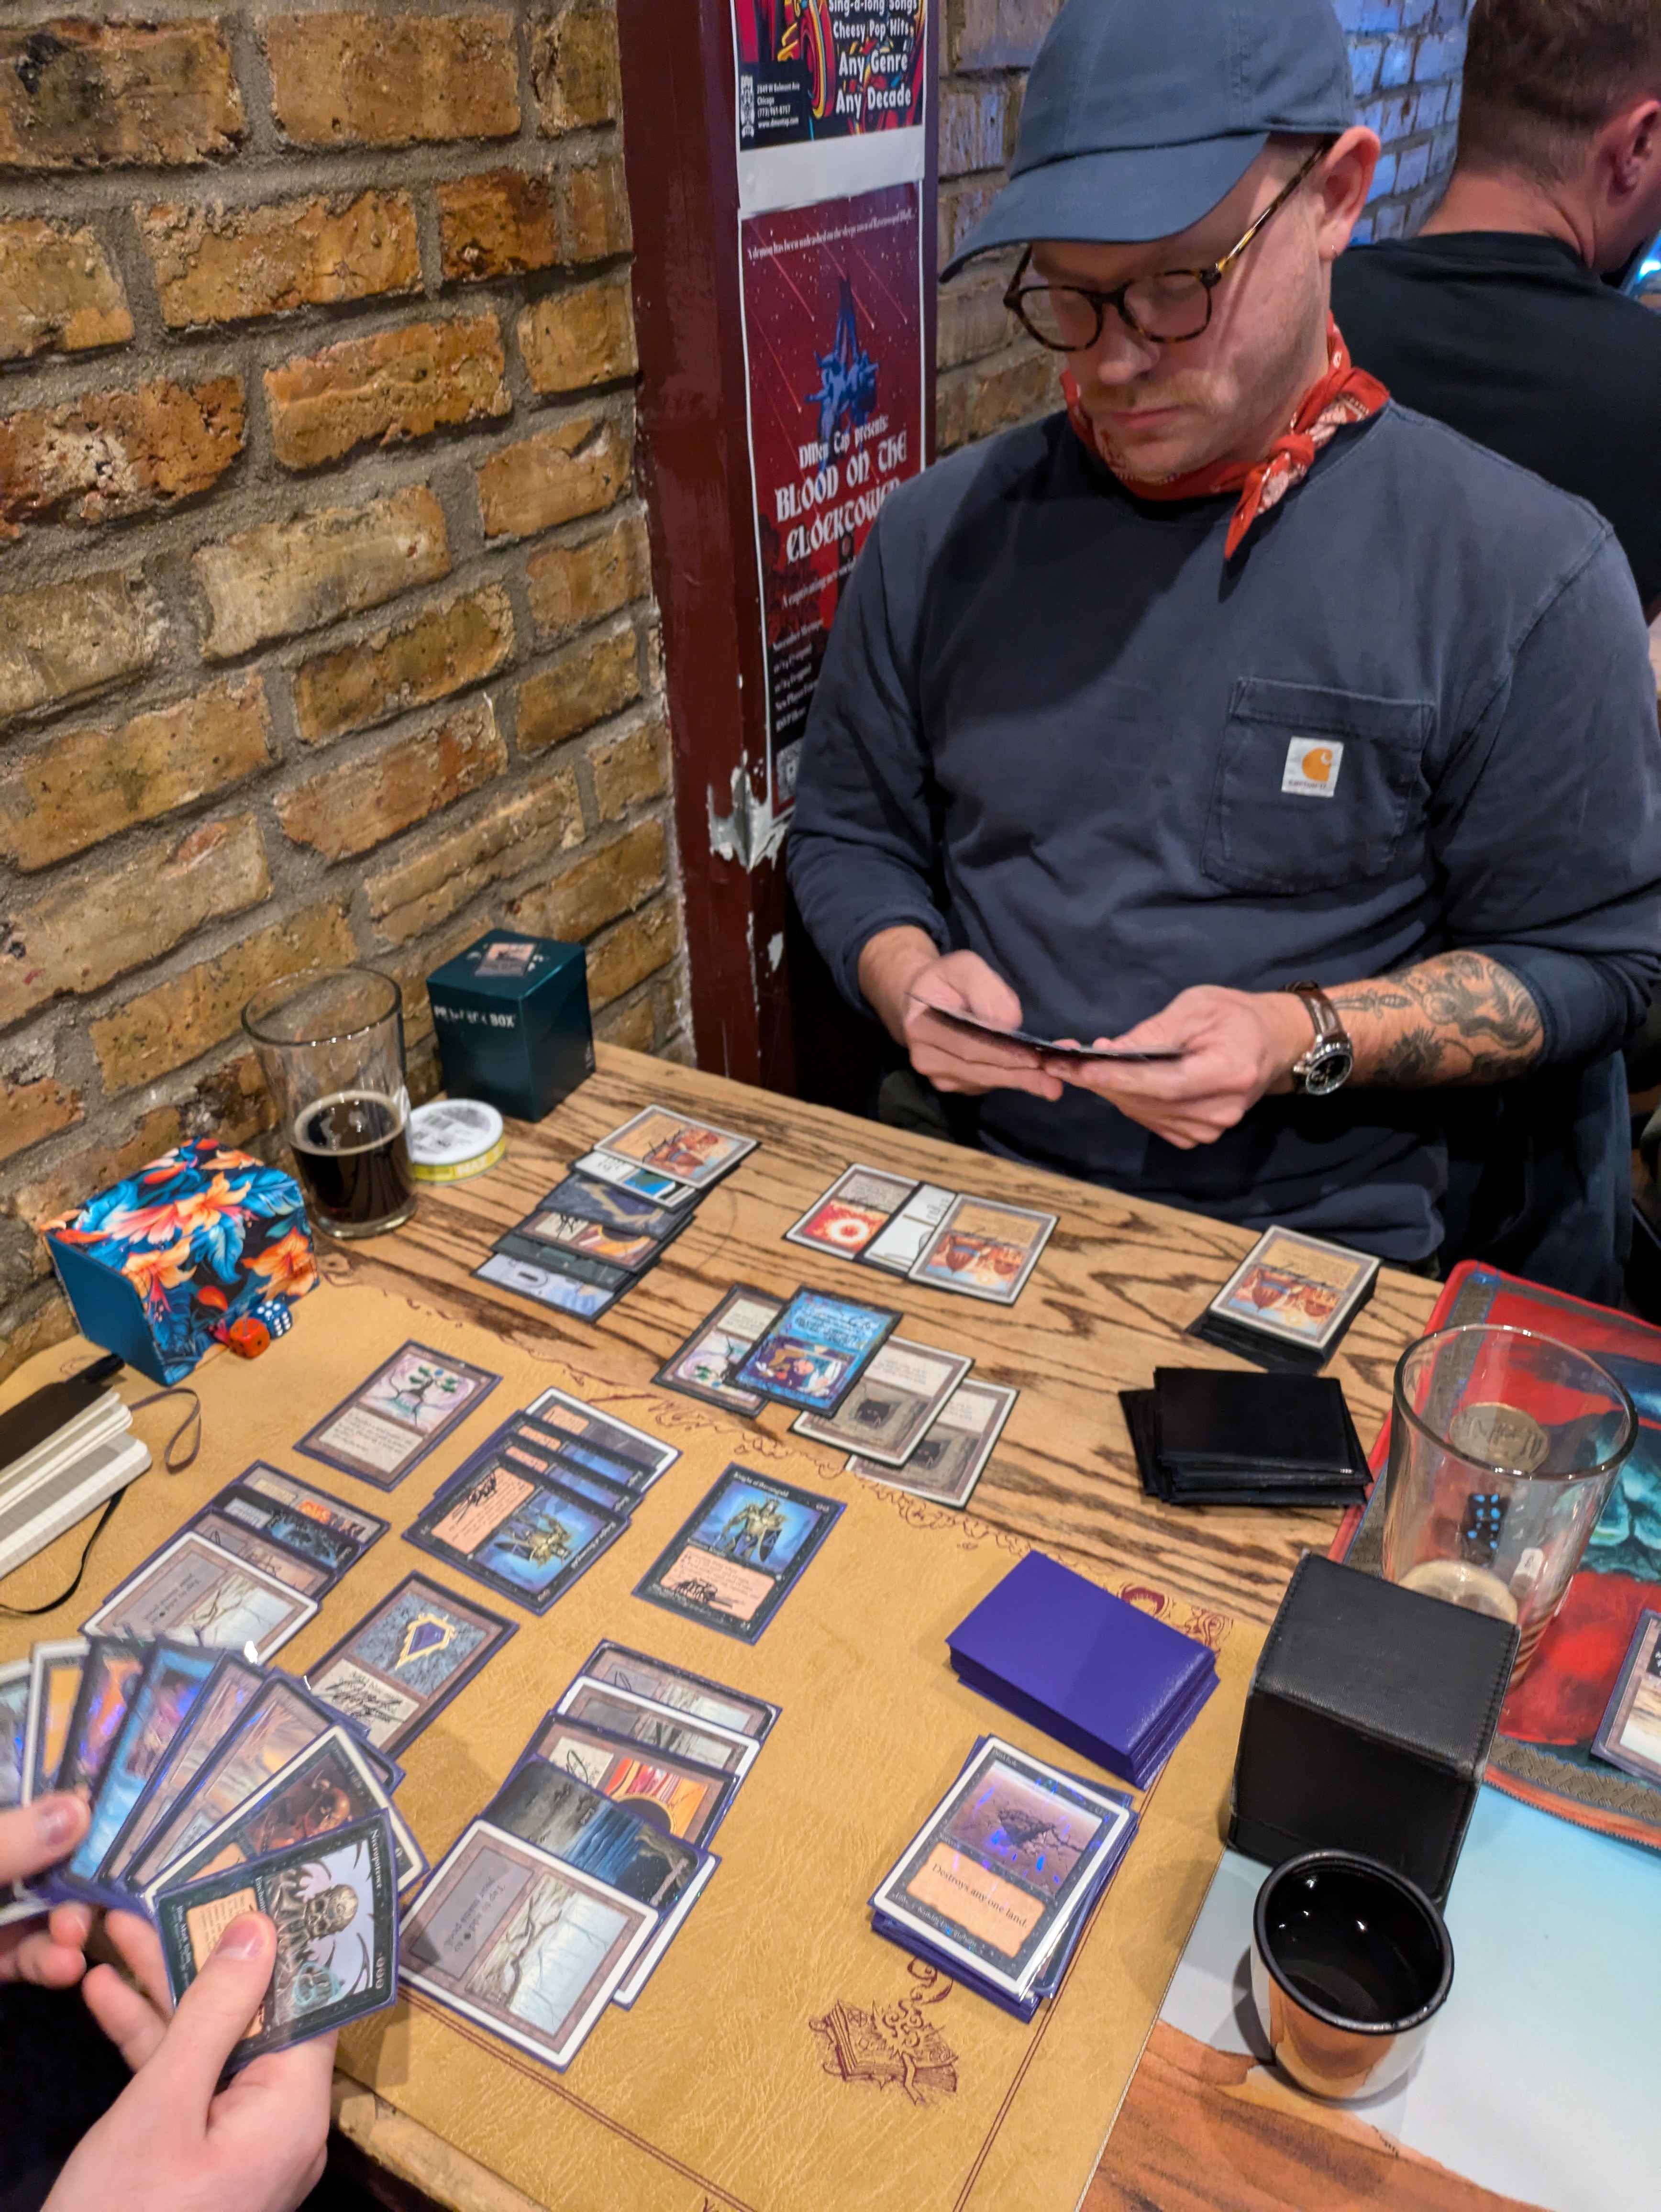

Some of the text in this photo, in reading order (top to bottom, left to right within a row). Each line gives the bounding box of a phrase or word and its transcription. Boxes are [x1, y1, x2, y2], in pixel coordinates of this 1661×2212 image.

[833, 18, 908, 43] Cheesy Pop Hits
[839, 49, 908, 83] Any Genre
[836, 83, 911, 120] Any Decade
[774, 465, 839, 523] BLOOD
[371, 1828, 382, 1889] Necropotence
[932, 1863, 1027, 1928] Destroys any one land.
